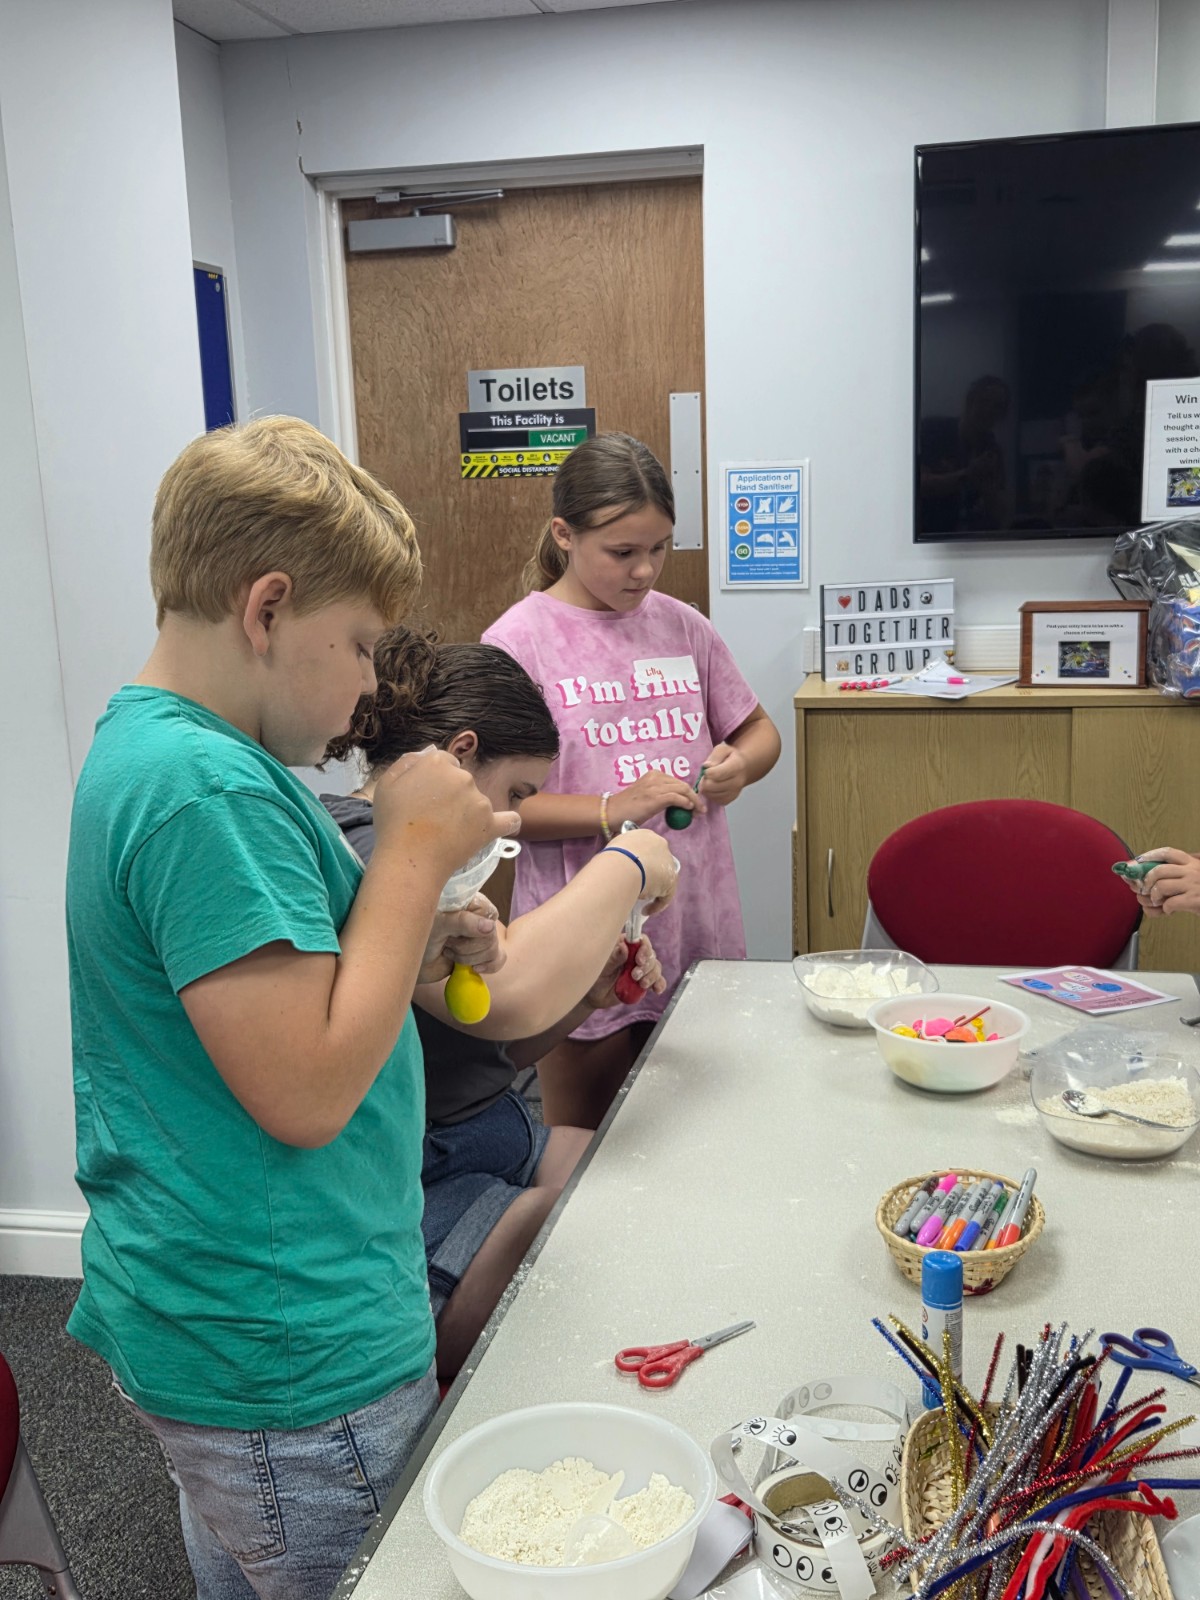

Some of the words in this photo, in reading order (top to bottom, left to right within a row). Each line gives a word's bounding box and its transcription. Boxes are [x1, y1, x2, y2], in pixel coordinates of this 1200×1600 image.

[479, 377, 574, 403] Toilets
[1175, 394, 1198, 404] Win
[490, 415, 513, 426] This
[516, 414, 553, 427] Facility
[555, 413, 565, 424] is
[1167, 412, 1181, 420] Tell
[1163, 424, 1193, 432] thought
[540, 432, 577, 444] VACANT
[1166, 434, 1198, 443] session,
[1165, 446, 1182, 454] with
[499, 466, 521, 474] SOCIAL
[738, 475, 782, 484] Application
[858, 587, 910, 612] DADS
[833, 617, 949, 645] TOGETHER
[855, 649, 930, 675] GROUP
[556, 675, 626, 709] I'm
[581, 707, 704, 748] totally
